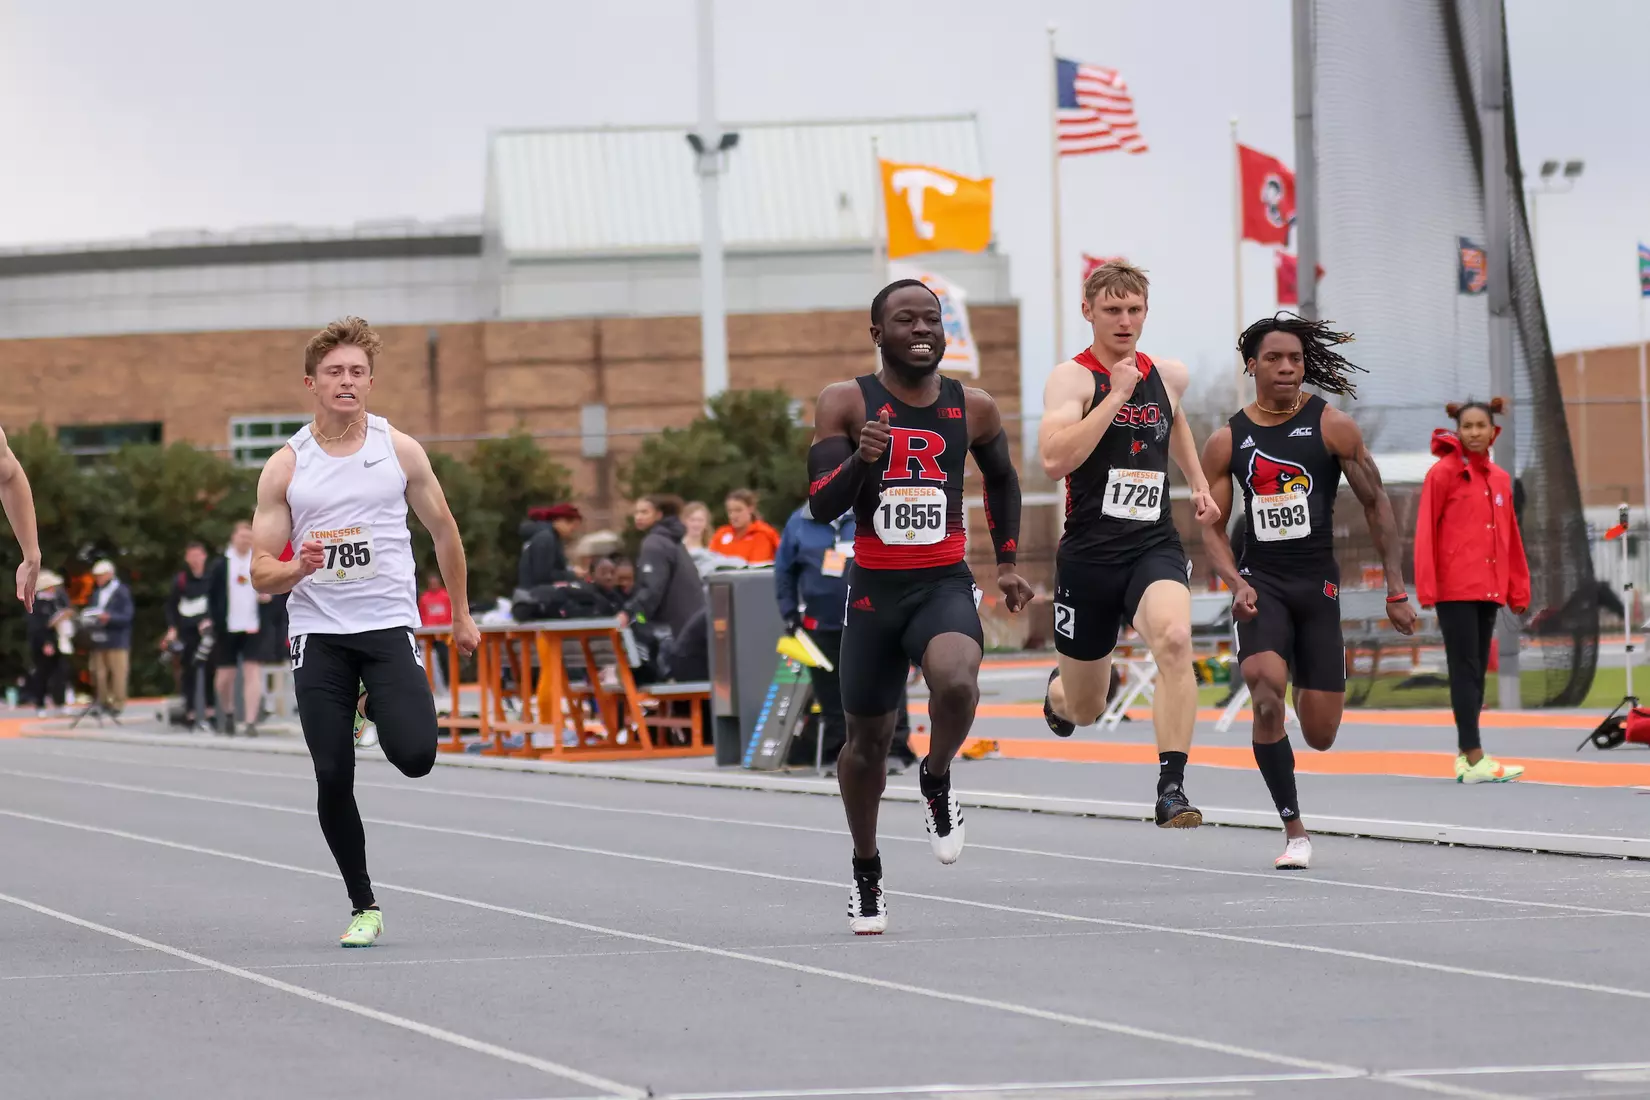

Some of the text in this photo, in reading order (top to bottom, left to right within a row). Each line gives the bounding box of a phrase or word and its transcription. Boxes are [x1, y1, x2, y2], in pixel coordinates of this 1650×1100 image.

[892, 168, 958, 240] T
[1115, 404, 1160, 426] SEMO
[1288, 427, 1313, 437] ACC
[882, 426, 948, 482] R
[1117, 470, 1159, 480] TENNESSEE
[884, 487, 937, 497] TENNESSEE
[1111, 482, 1160, 509] 1726
[1257, 493, 1298, 504] TENNESSEE
[880, 503, 942, 530] 1855
[1257, 504, 1306, 530] 1593
[310, 526, 361, 539] TENNESSEE
[323, 541, 371, 569] 785
[1057, 605, 1071, 636] 2
